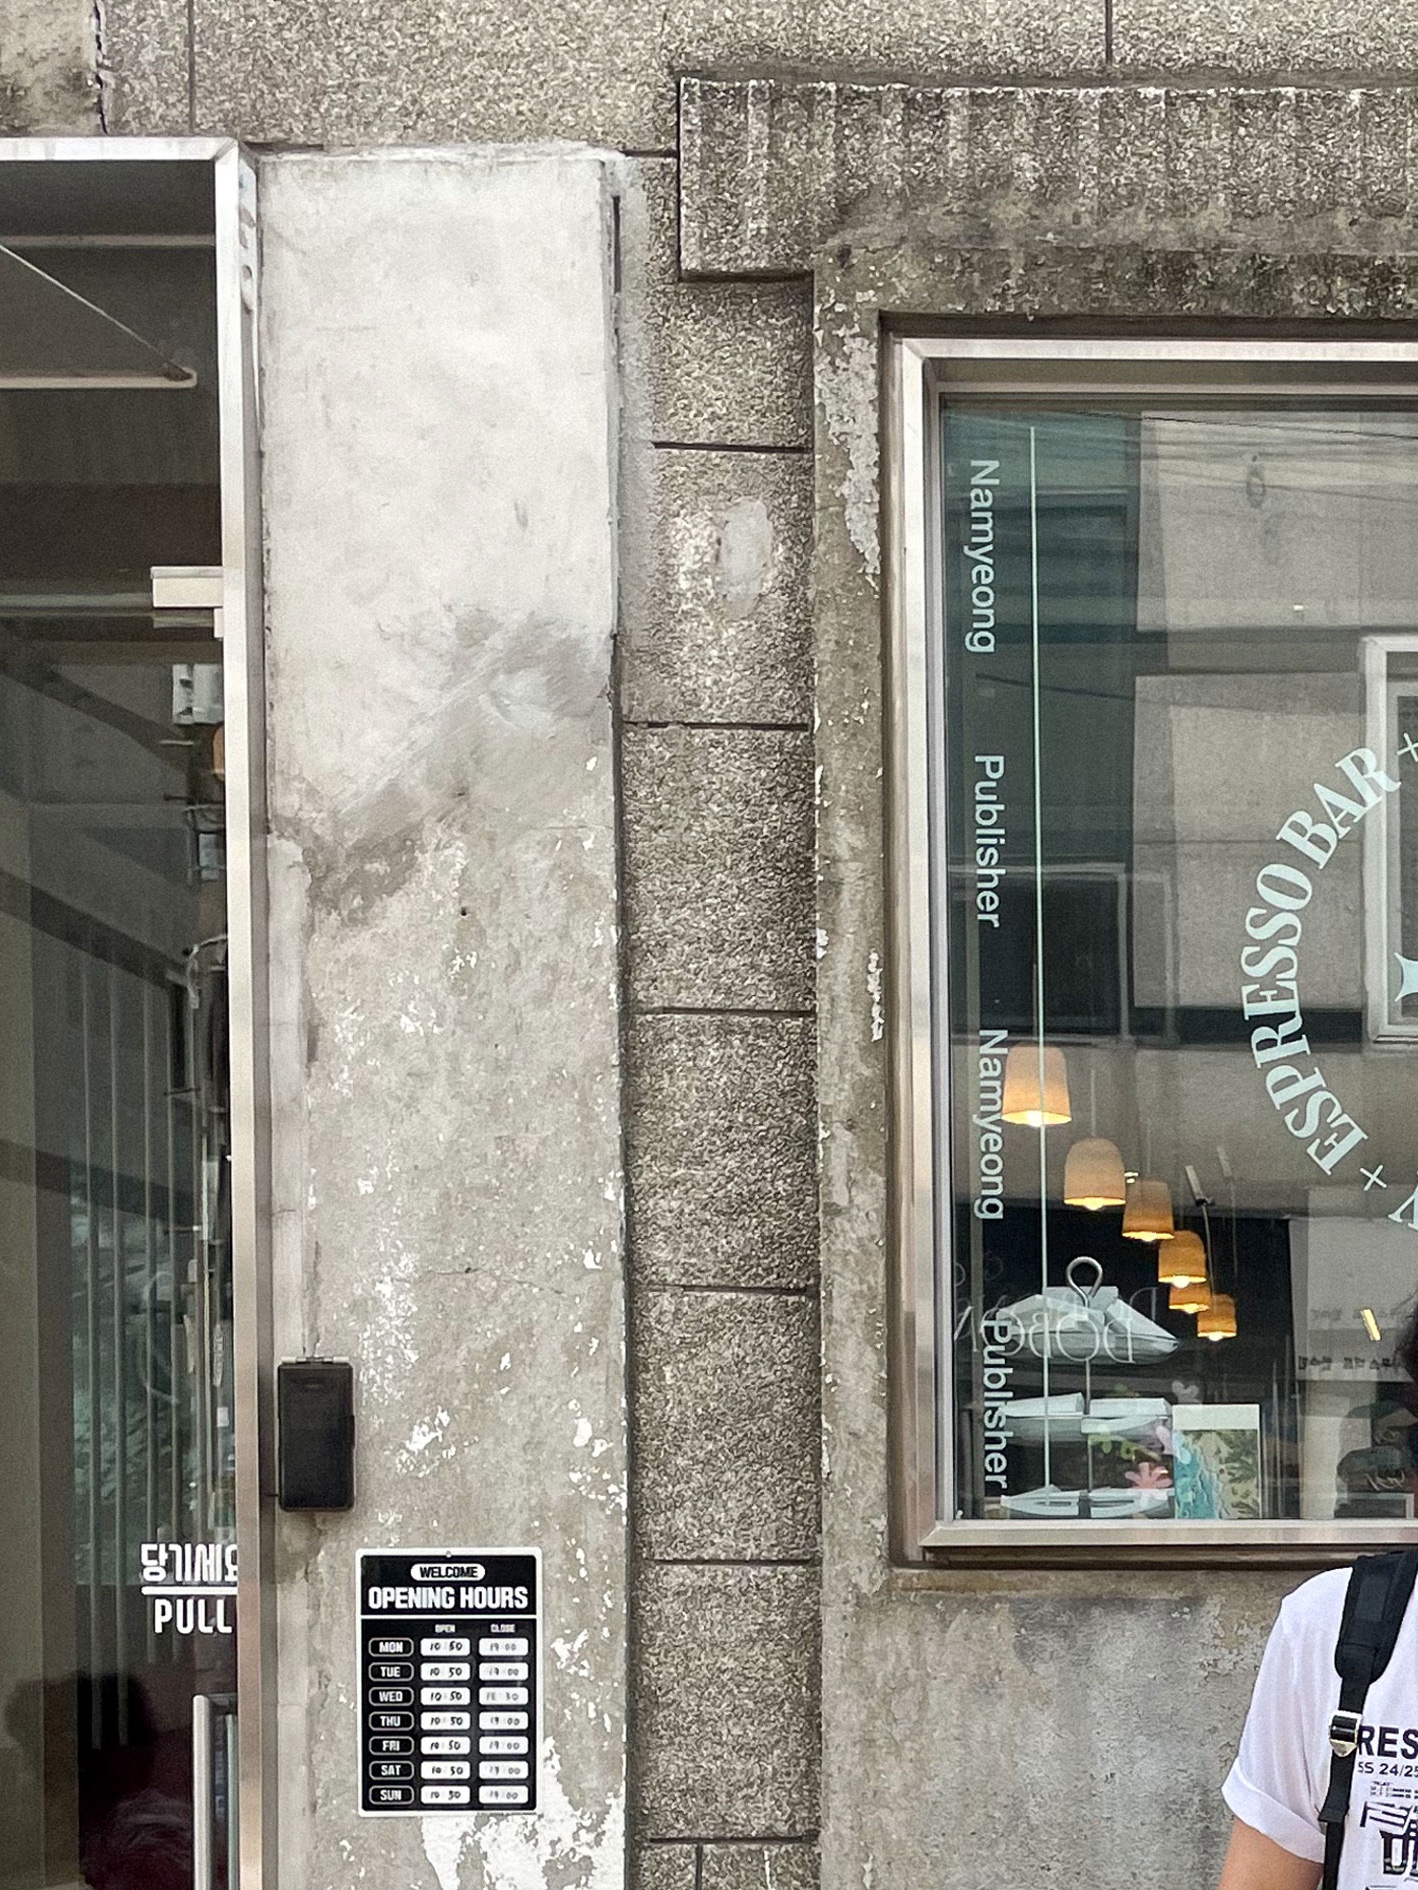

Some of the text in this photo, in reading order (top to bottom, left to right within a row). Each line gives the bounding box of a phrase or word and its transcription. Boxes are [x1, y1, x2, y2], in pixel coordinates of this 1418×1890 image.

[1276, 746, 1402, 870] BAR
[963, 458, 1011, 1489] Namyeong Publisher Namyeong Publisher
[1240, 863, 1368, 1176] ESPRESSO
[419, 1566, 479, 1579] WELCOME
[368, 1586, 529, 1609] OPENING HOURS
[154, 1598, 233, 1634] PULL
[434, 1623, 456, 1633] OPEN
[379, 1641, 403, 1653] MON
[380, 1666, 401, 1677] TUE
[379, 1691, 403, 1702] WED
[380, 1715, 401, 1727] THU
[382, 1740, 401, 1751] FRI
[381, 1765, 401, 1776] SAT
[380, 1789, 402, 1801] SUN
